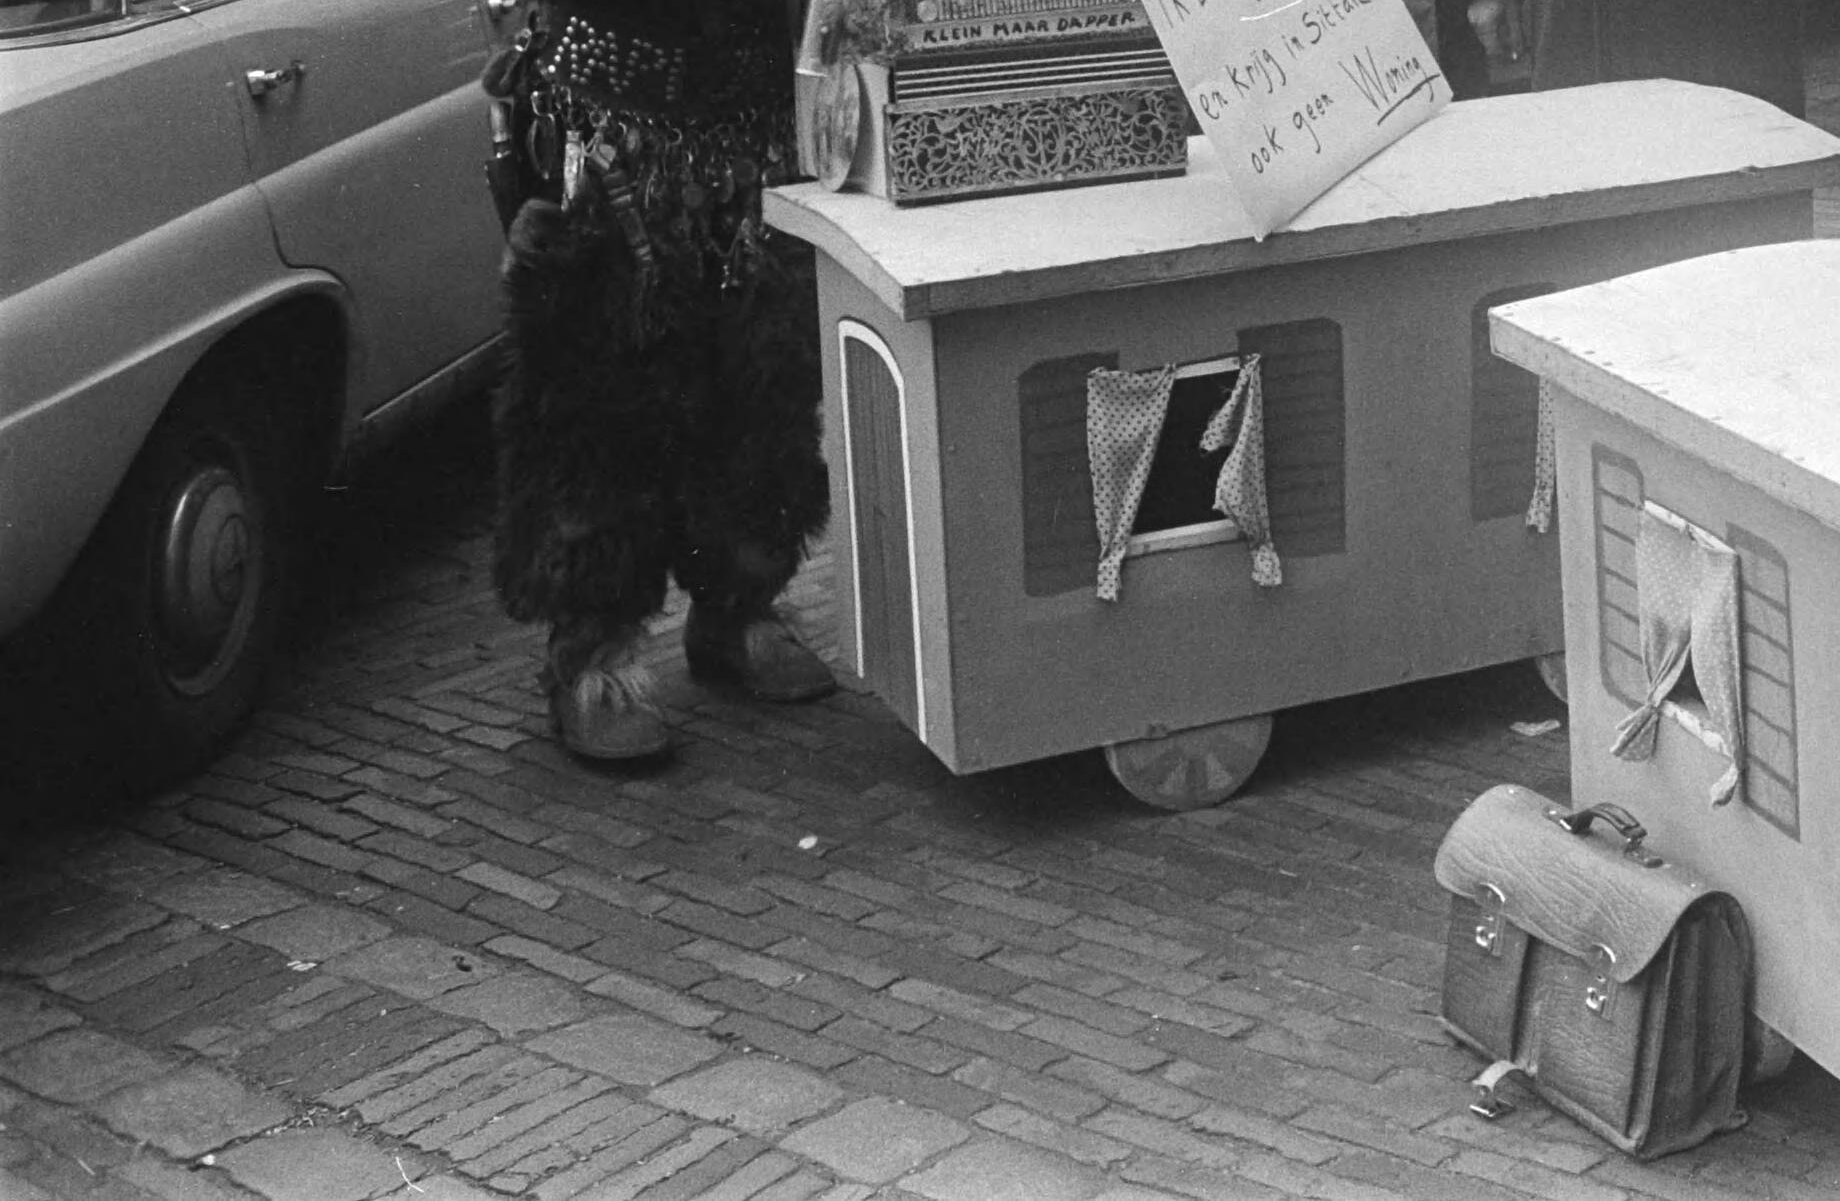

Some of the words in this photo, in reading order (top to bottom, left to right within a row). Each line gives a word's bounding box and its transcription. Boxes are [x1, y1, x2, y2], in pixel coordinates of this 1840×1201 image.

[922, 25, 982, 44] KLEIN
[992, 19, 1049, 37] MAAR
[1056, 11, 1136, 32] DAPPER
[1292, 93, 1334, 154] geen
